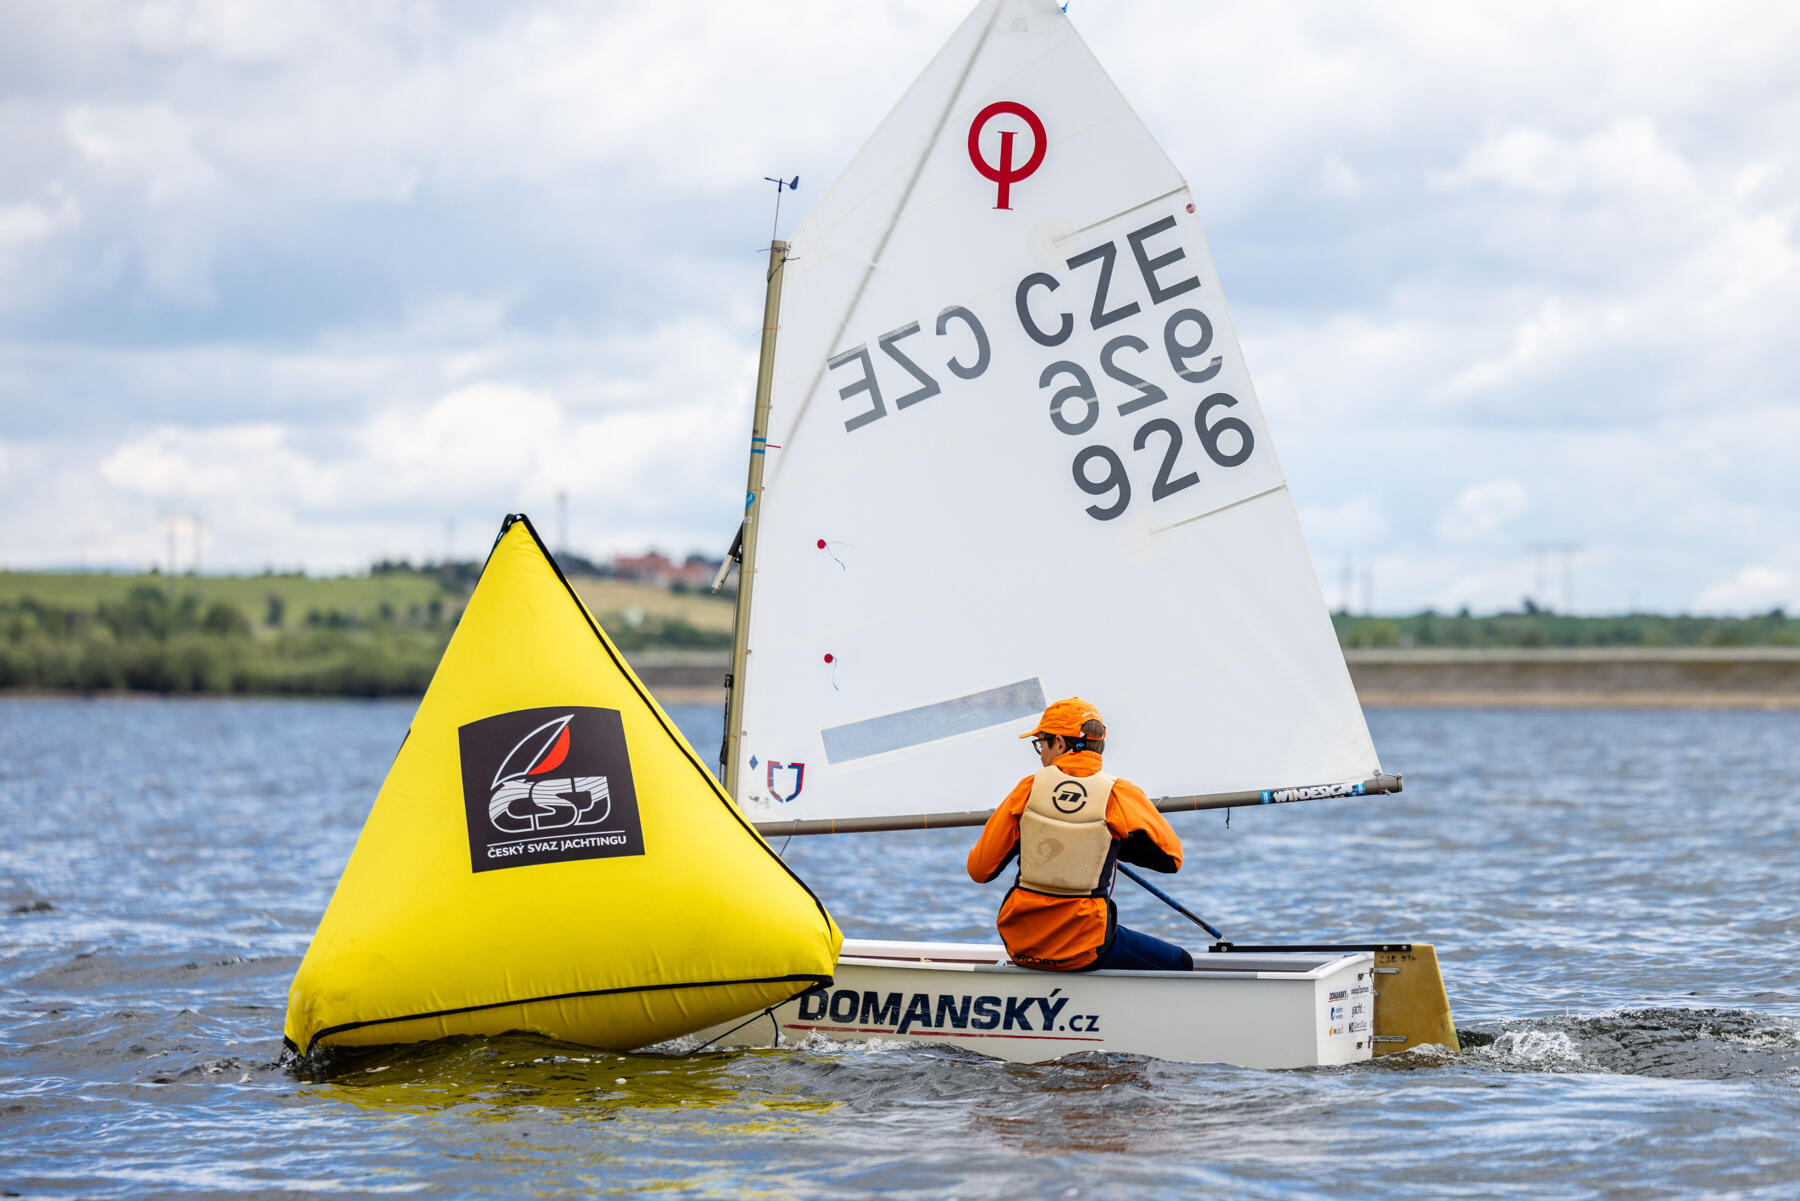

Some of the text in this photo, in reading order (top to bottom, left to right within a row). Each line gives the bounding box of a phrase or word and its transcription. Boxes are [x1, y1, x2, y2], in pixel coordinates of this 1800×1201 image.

[1016, 215, 1201, 347] CZE
[1072, 393, 1254, 521] 926
[487, 836, 627, 859] ČESKÝ SVAZ JACHTINGU
